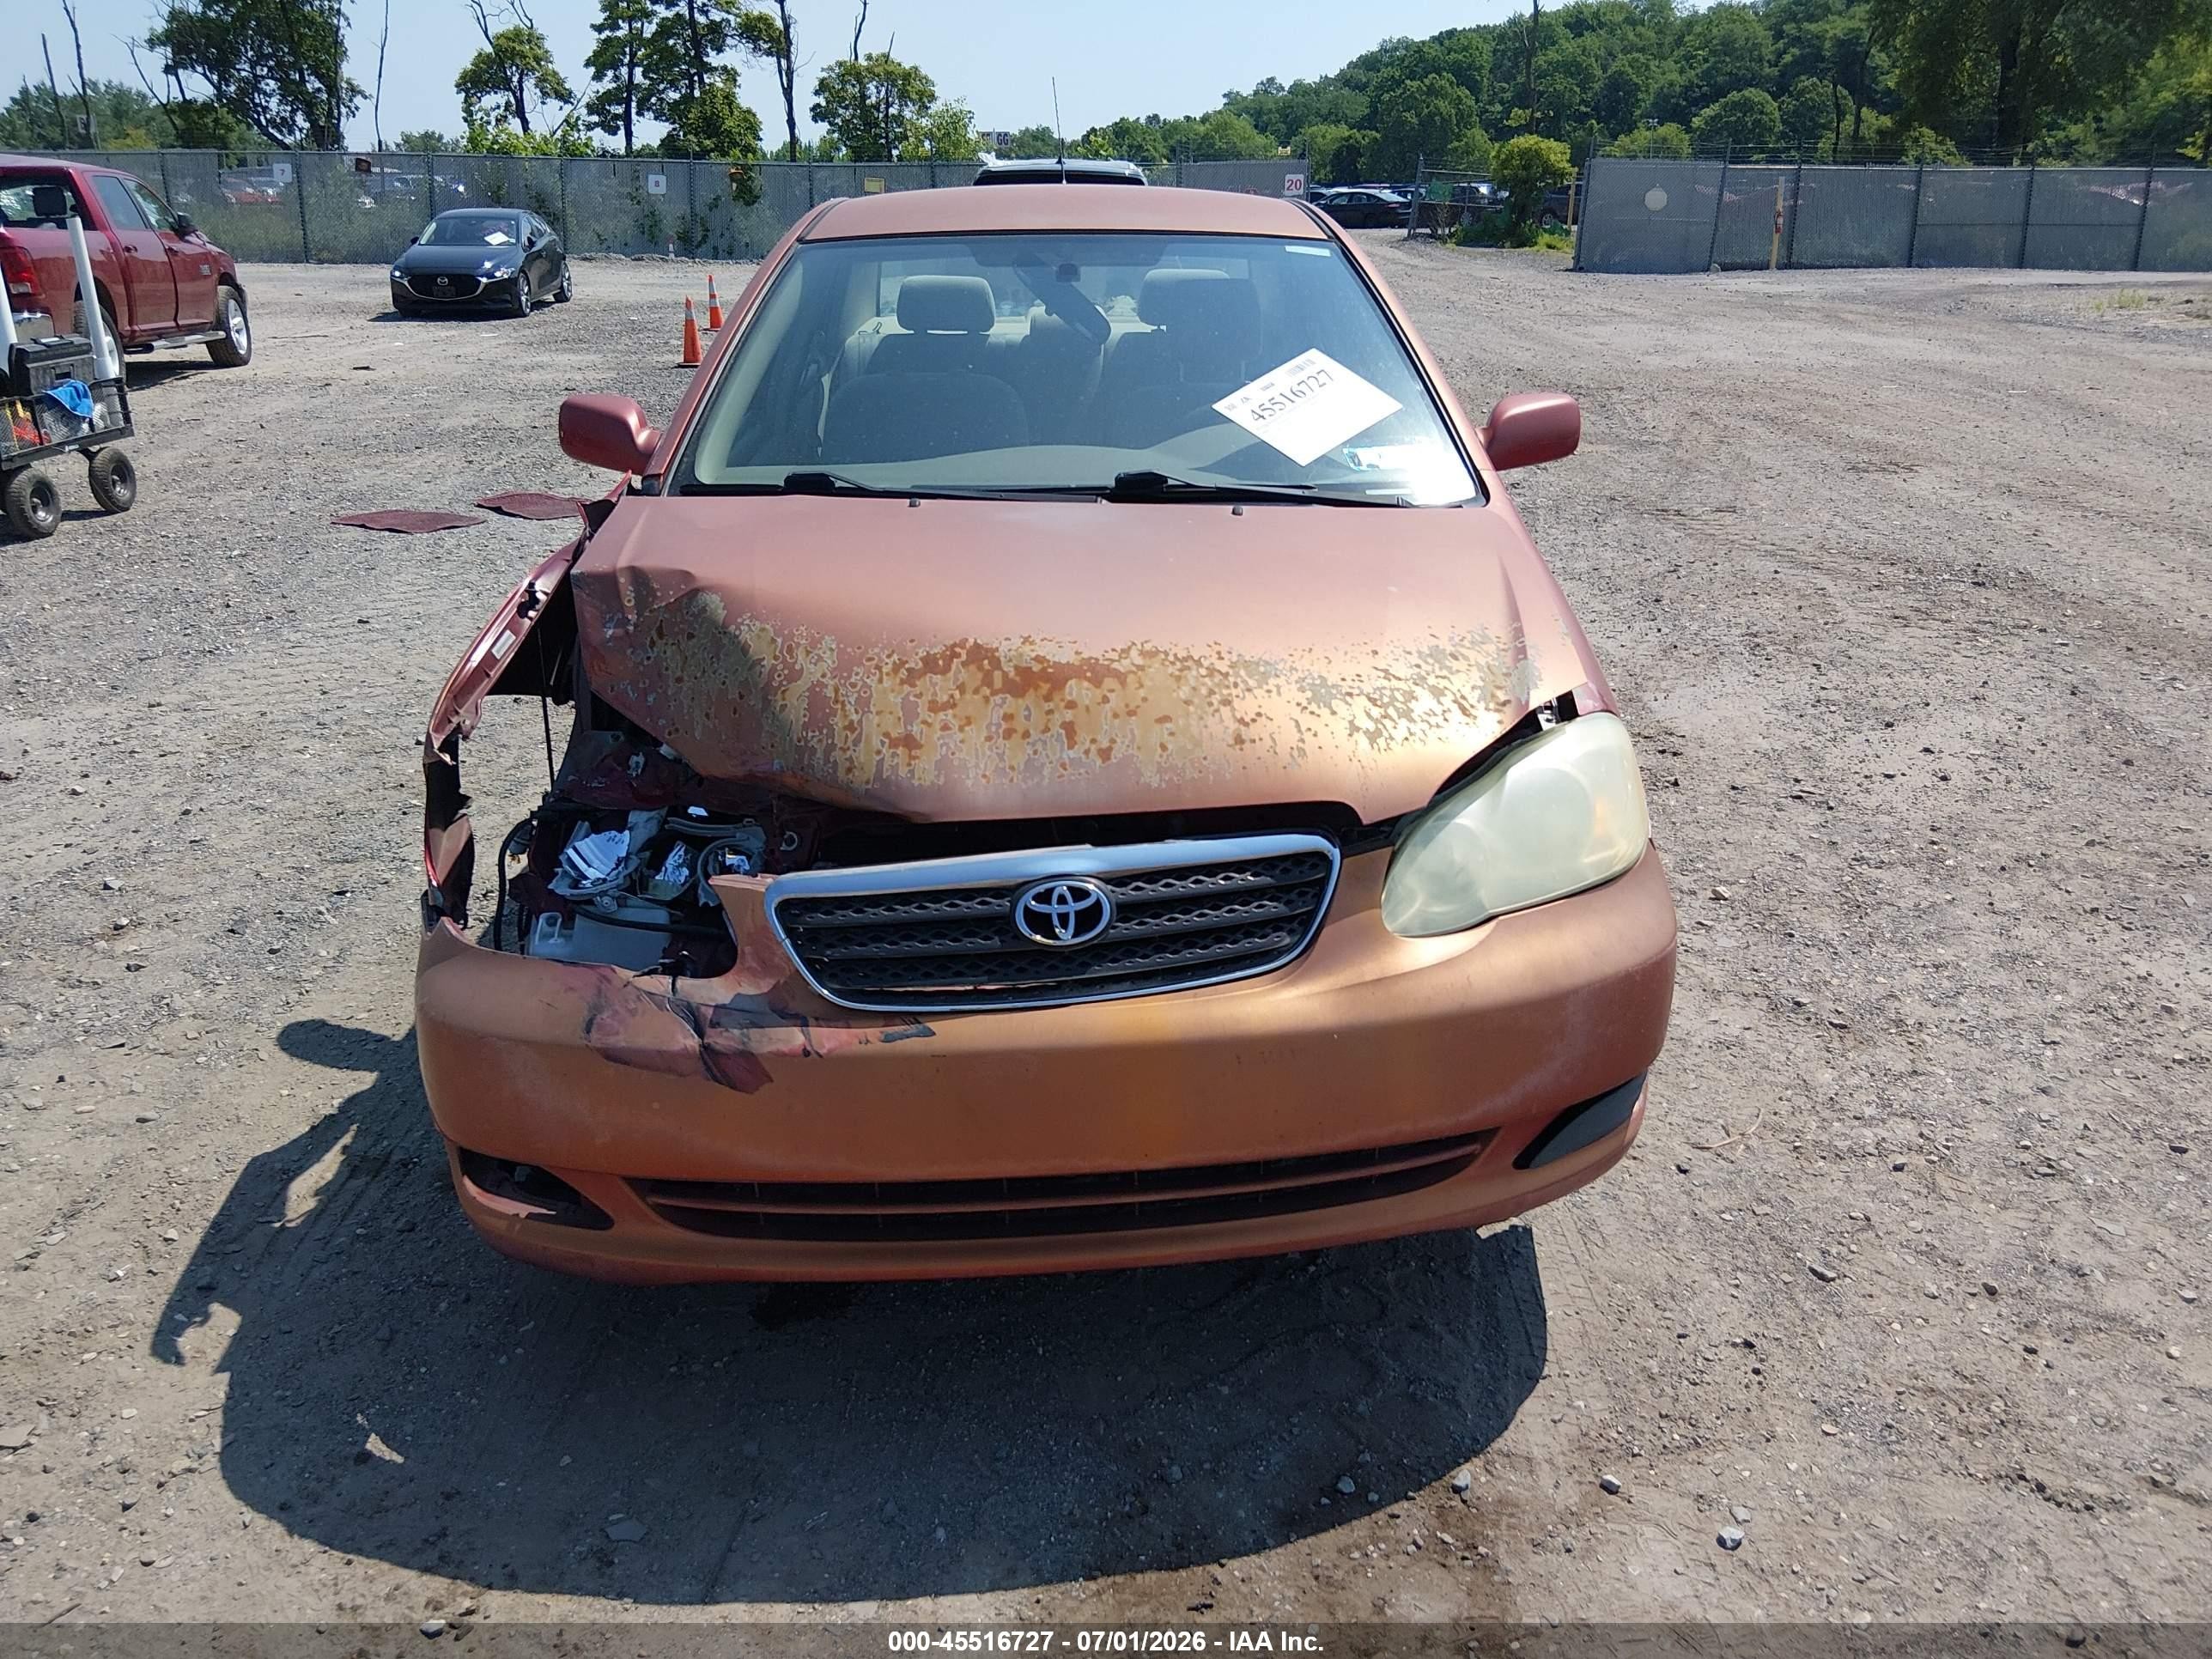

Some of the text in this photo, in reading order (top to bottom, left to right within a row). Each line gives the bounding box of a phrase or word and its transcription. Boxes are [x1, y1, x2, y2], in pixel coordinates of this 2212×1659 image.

[997, 133, 1009, 146] GG
[1285, 179, 1303, 191] 20
[1249, 368, 1334, 422] 45516727
